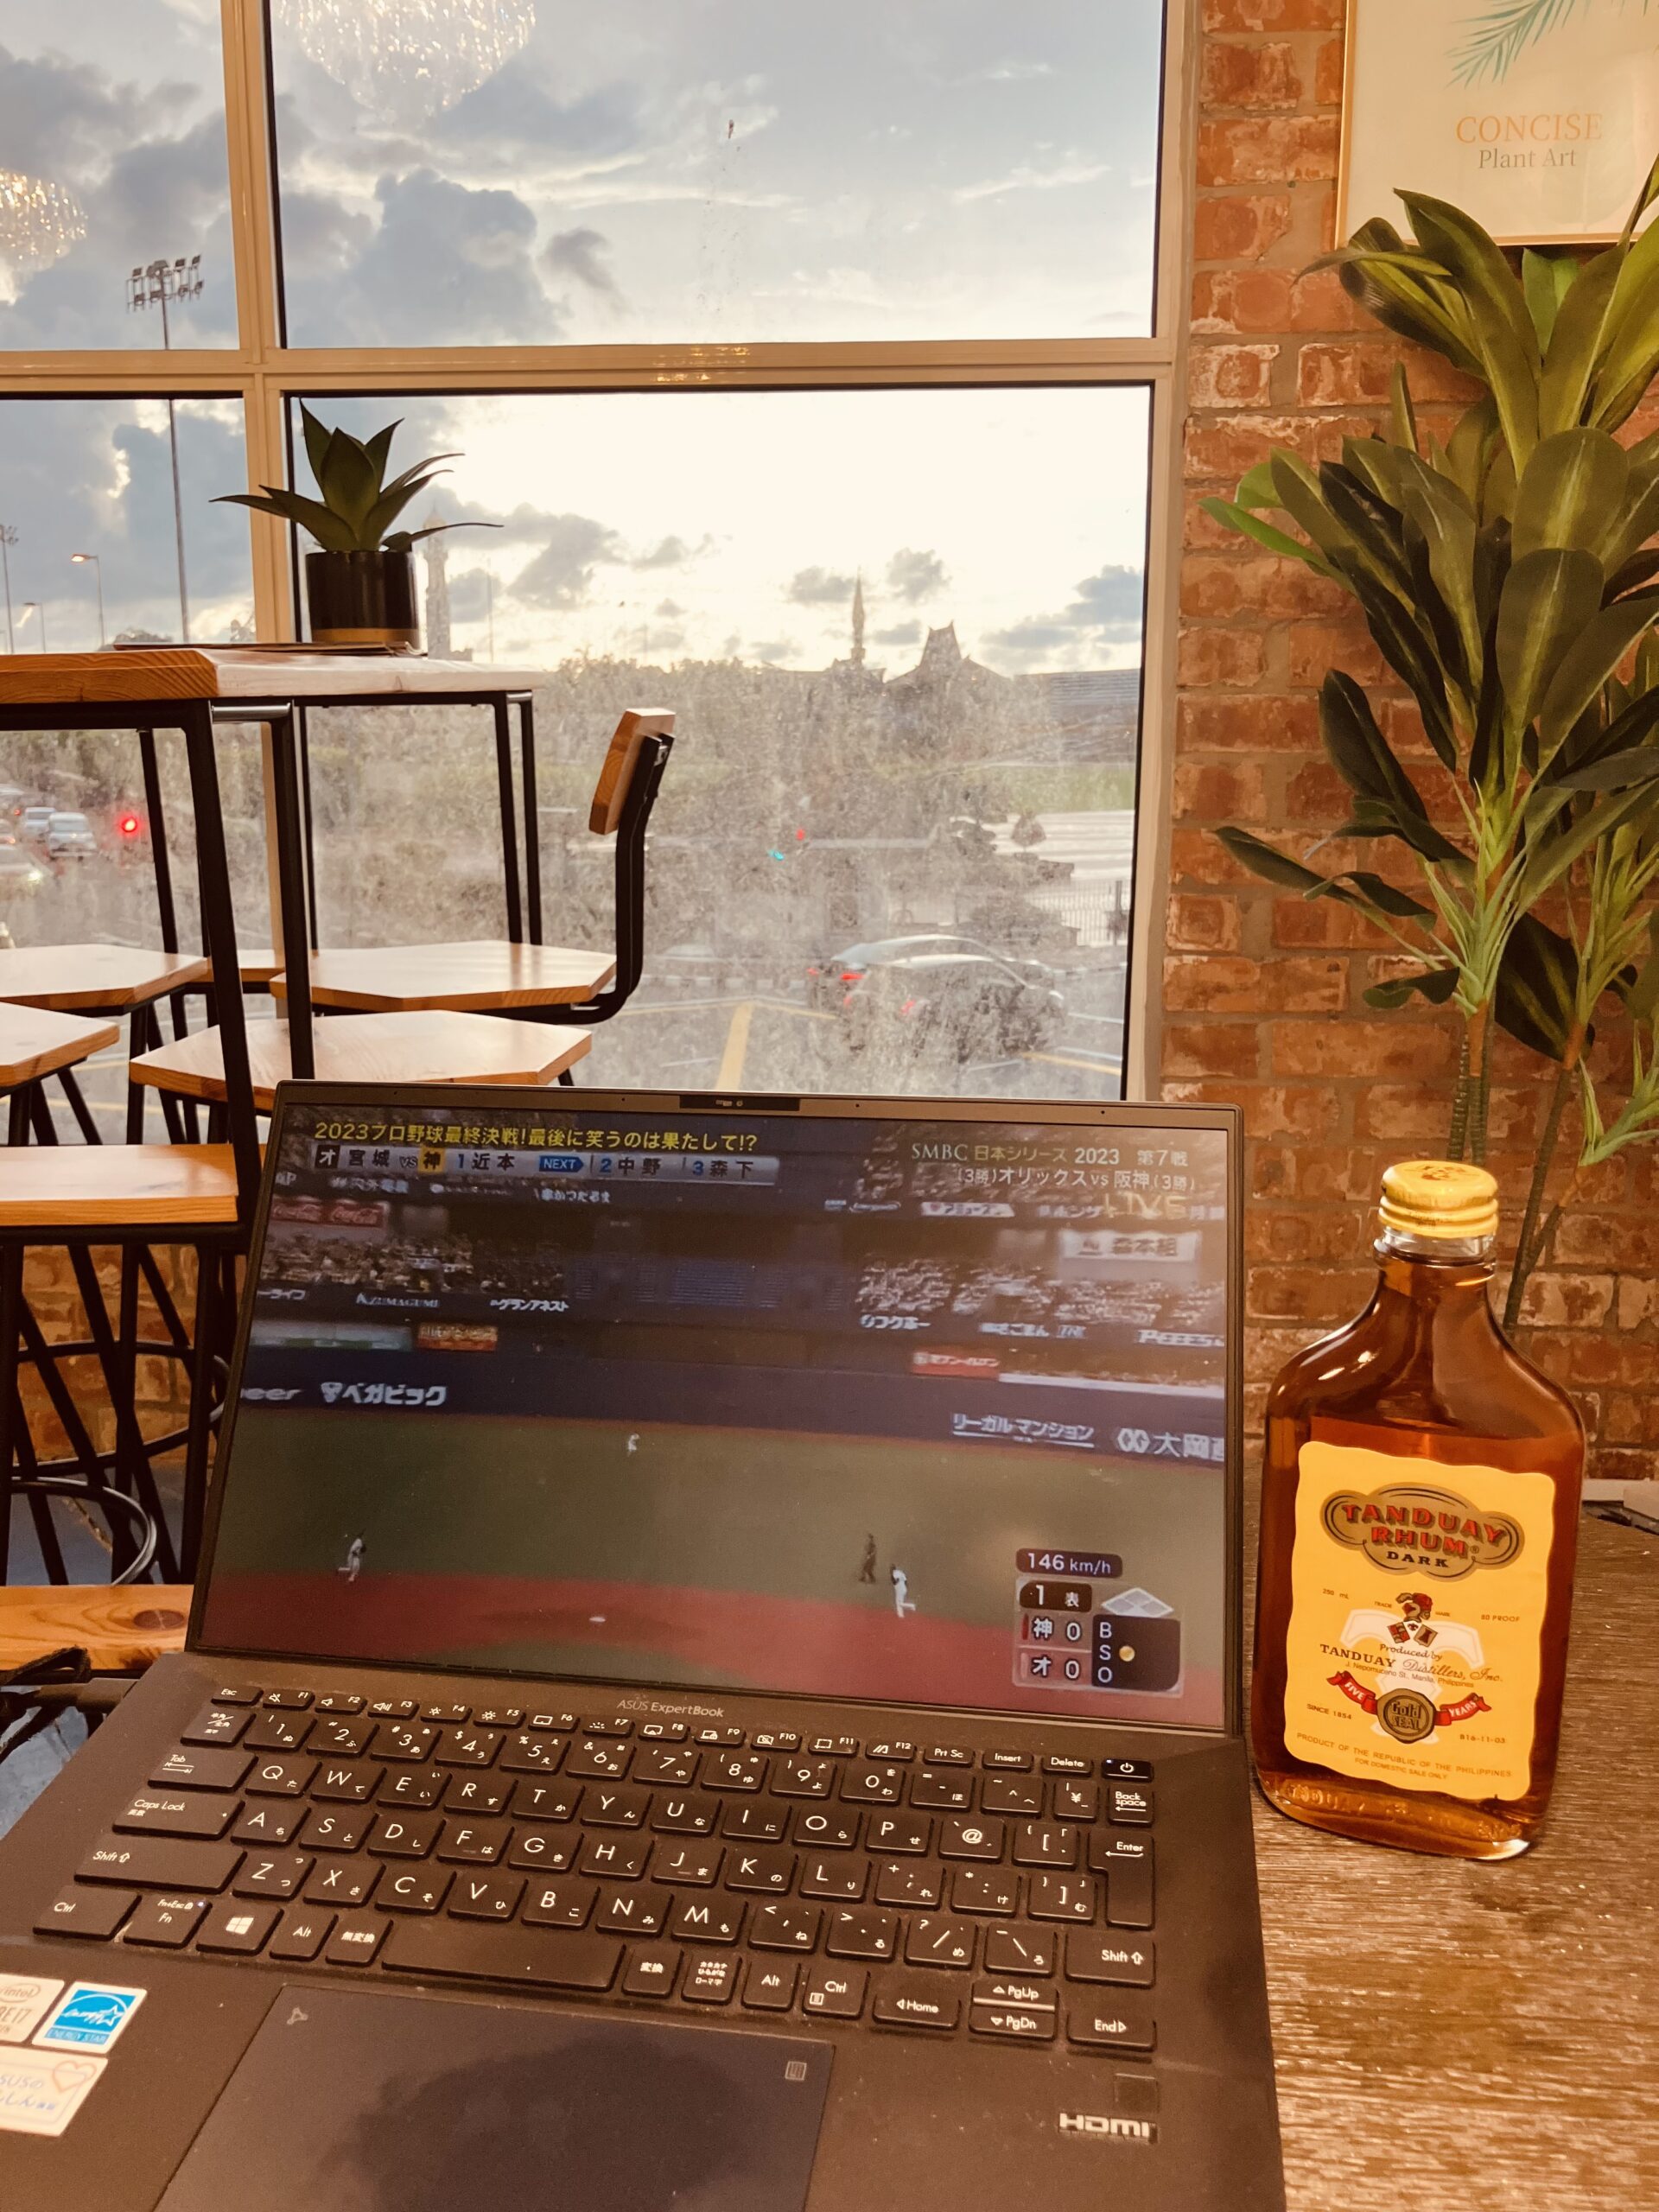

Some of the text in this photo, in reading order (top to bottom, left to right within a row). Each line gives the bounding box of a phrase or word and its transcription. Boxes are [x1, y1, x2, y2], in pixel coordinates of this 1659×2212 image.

[1456, 113, 1603, 143] CONCISE
[1478, 148, 1577, 168] Plant Art
[319, 1150, 335, 1166] オ
[349, 1149, 390, 1167] 宮城
[423, 1152, 442, 1170] 神
[472, 1154, 516, 1171] 近本
[912, 1143, 969, 1161] SMBC
[1075, 1147, 1120, 1165] 2023
[543, 1159, 576, 1170] NEXT
[599, 1157, 662, 1176] 2 中野
[692, 1160, 754, 1179] 3 森下
[1342, 1504, 1507, 1547] TANDUAY
[1371, 1526, 1468, 1558] RHUM
[1027, 1553, 1111, 1575] 146 km/h
[1387, 1551, 1448, 1567] DARK
[1036, 1585, 1045, 1605] 1
[1033, 1618, 1081, 1641] 神 0
[1099, 1622, 1112, 1638] B
[1099, 1645, 1111, 1661] S
[1319, 1643, 1396, 1668] TANDUAY
[1380, 1643, 1443, 1662] Produced by
[1032, 1656, 1080, 1680] オ 0
[1344, 1681, 1365, 1700] FIVE
[617, 1700, 725, 1718] ASUS ExpertBook
[1306, 1703, 1352, 1719] SINCE 1854
[334, 1729, 349, 1740] 2
[399, 1734, 412, 1745] 3
[462, 1740, 476, 1751] 4
[528, 1745, 543, 1757] 5
[594, 1751, 607, 1763] 6
[995, 1753, 1021, 1762] Insert
[1297, 1732, 1335, 1748] PRODUCT
[1353, 1747, 1369, 1757] THE
[1373, 1752, 1416, 1765] REPUBLIC
[1455, 1766, 1512, 1777] PHILIPPINES
[660, 1758, 676, 1769] 7
[1052, 1758, 1084, 1767] Delete
[263, 1766, 283, 1780] Q
[729, 1764, 741, 1776] 8
[798, 1770, 810, 1781] 9
[327, 1770, 352, 1785] W
[396, 1777, 411, 1790] E
[461, 1783, 476, 1796] R
[534, 1789, 546, 1802] T
[135, 1800, 185, 1810] Caps Lock
[601, 1796, 615, 1809] Y
[668, 1802, 683, 1816] U
[248, 1812, 264, 1827] A
[319, 1819, 334, 1833] S
[385, 1824, 403, 1838] D
[881, 1821, 893, 1835] P
[457, 1830, 473, 1844] F
[524, 1838, 544, 1853] G
[595, 1845, 615, 1860] H
[1117, 1841, 1143, 1851] Enter
[93, 1851, 118, 1860] Shift
[671, 1853, 684, 1866] J
[252, 1863, 274, 1879] Z
[741, 1859, 757, 1873] K
[323, 1870, 342, 1886] X
[817, 1866, 828, 1881] L
[395, 1877, 416, 1892] C
[472, 1883, 487, 1899] V
[541, 1891, 556, 1907] B
[54, 1903, 75, 1912] Ctrl
[613, 1898, 633, 1915] N
[159, 1913, 172, 1923] Fn
[684, 1906, 708, 1923] M
[293, 1927, 311, 1936] Alt
[1102, 1950, 1128, 1962] Shift
[761, 1974, 779, 1986] Alt
[825, 1981, 846, 1993] Ctrl
[1008, 1986, 1039, 2000] PgUp
[906, 2000, 938, 2013] Home
[1007, 2016, 1036, 2031] PgDn
[1095, 2019, 1116, 2032] End
